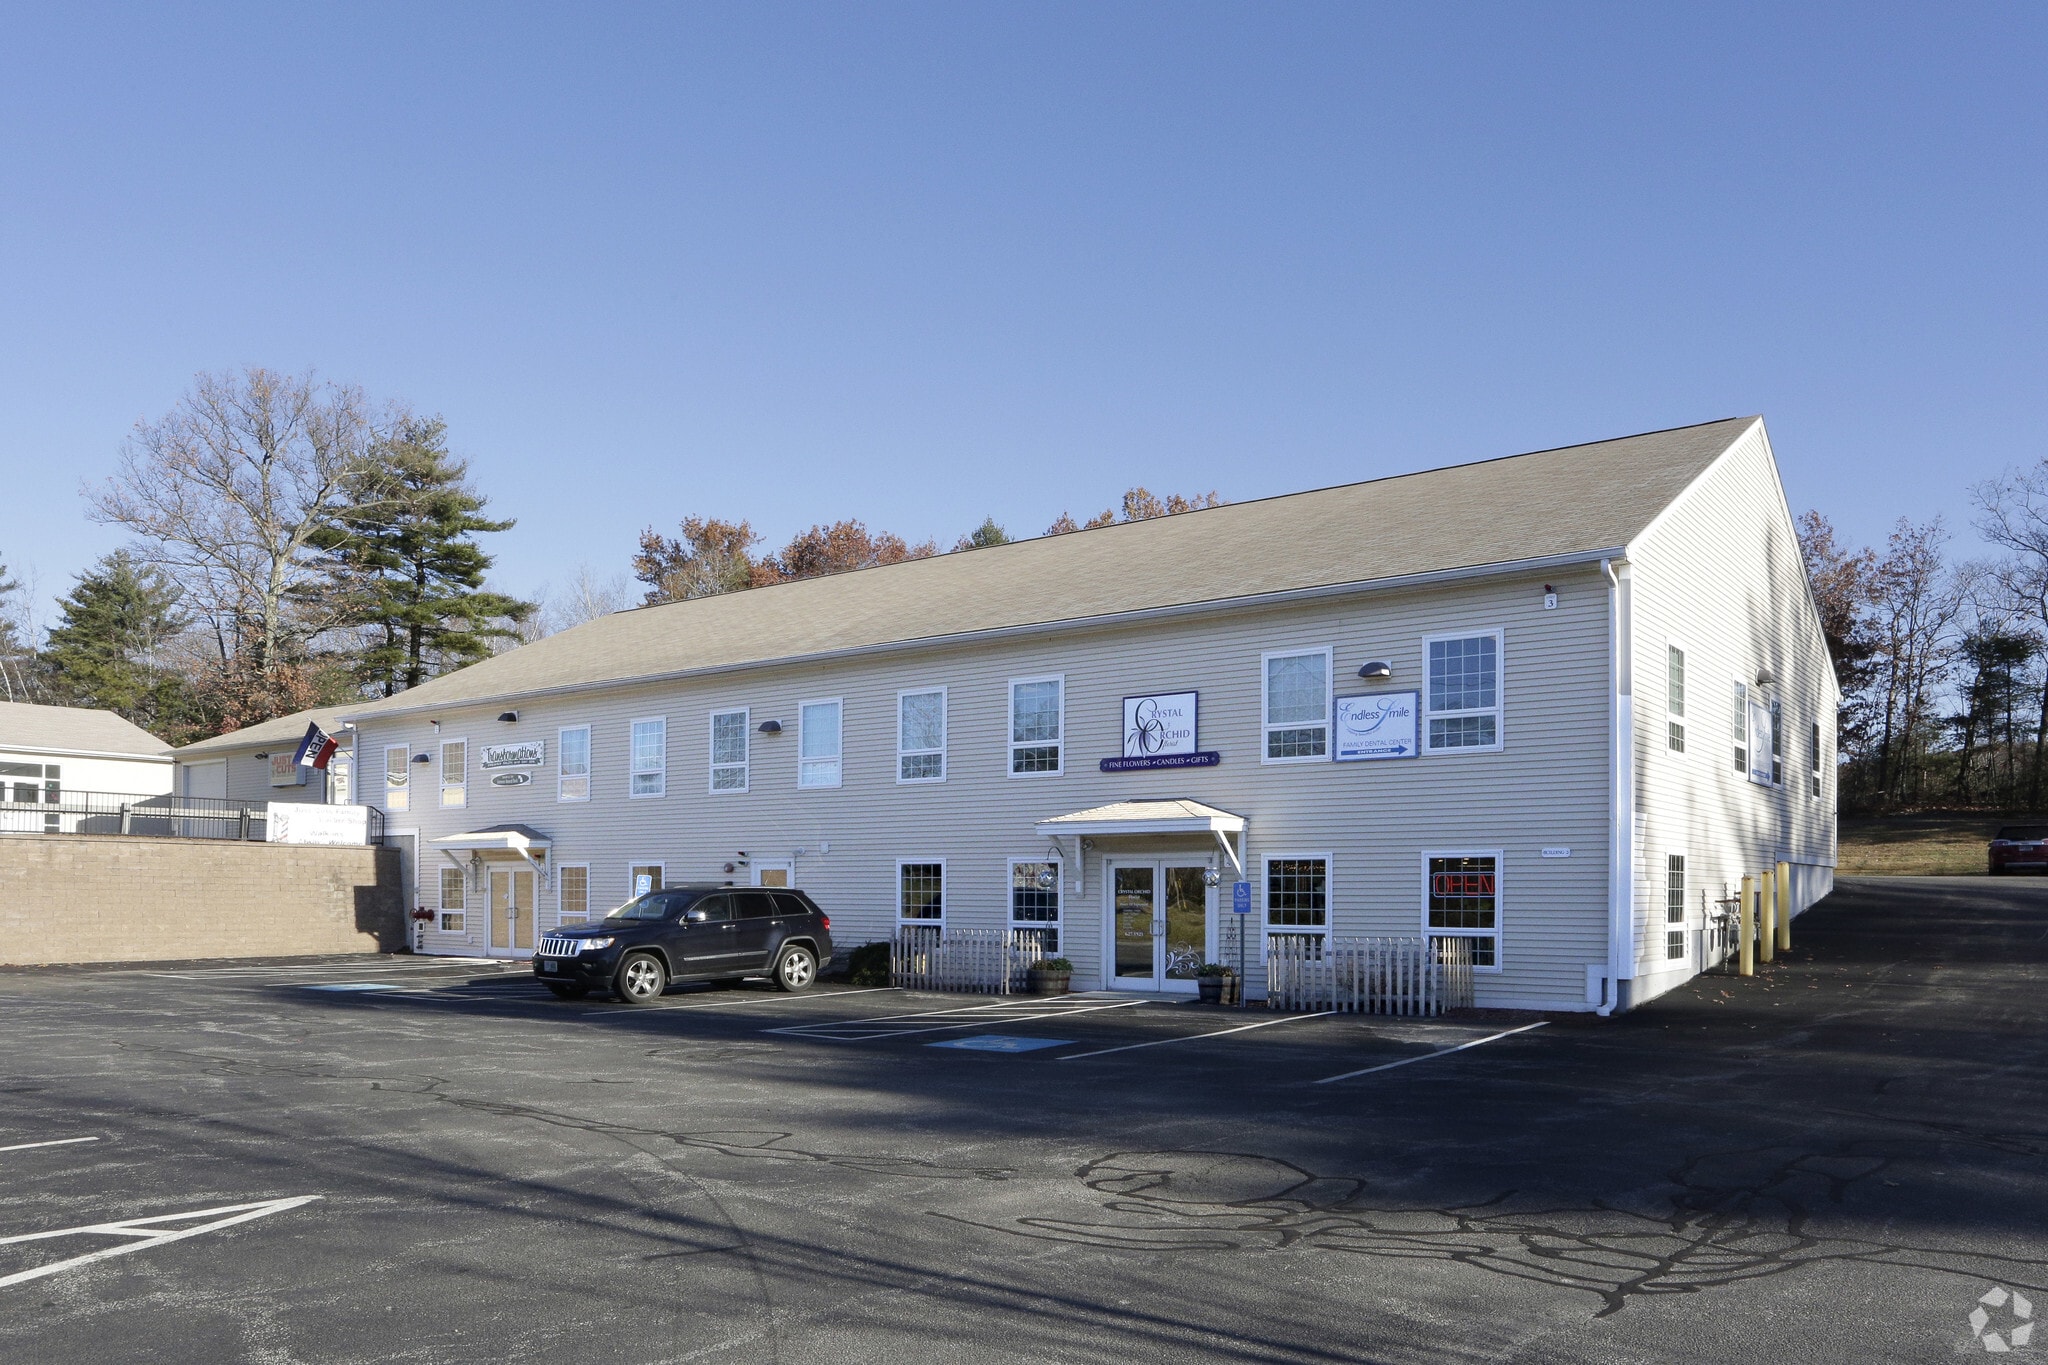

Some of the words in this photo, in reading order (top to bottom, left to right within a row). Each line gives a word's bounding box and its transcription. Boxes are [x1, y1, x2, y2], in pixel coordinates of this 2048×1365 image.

[1547, 599, 1554, 608] 3
[1135, 698, 1184, 732] CRYSTAL
[1339, 702, 1380, 722] Endless
[1143, 718, 1190, 753] ORCHID
[1343, 740, 1364, 748] FAMILY
[1365, 739, 1388, 747] DENTAL
[1388, 738, 1412, 746] CENTER
[272, 754, 293, 765] JUST
[1109, 761, 1122, 769] FINE
[1122, 759, 1151, 768] FLOWERS
[1156, 757, 1185, 766] CANDLES
[1190, 756, 1209, 764] GIFTS
[276, 764, 297, 774] CUTS
[1435, 874, 1495, 895] OPEN
